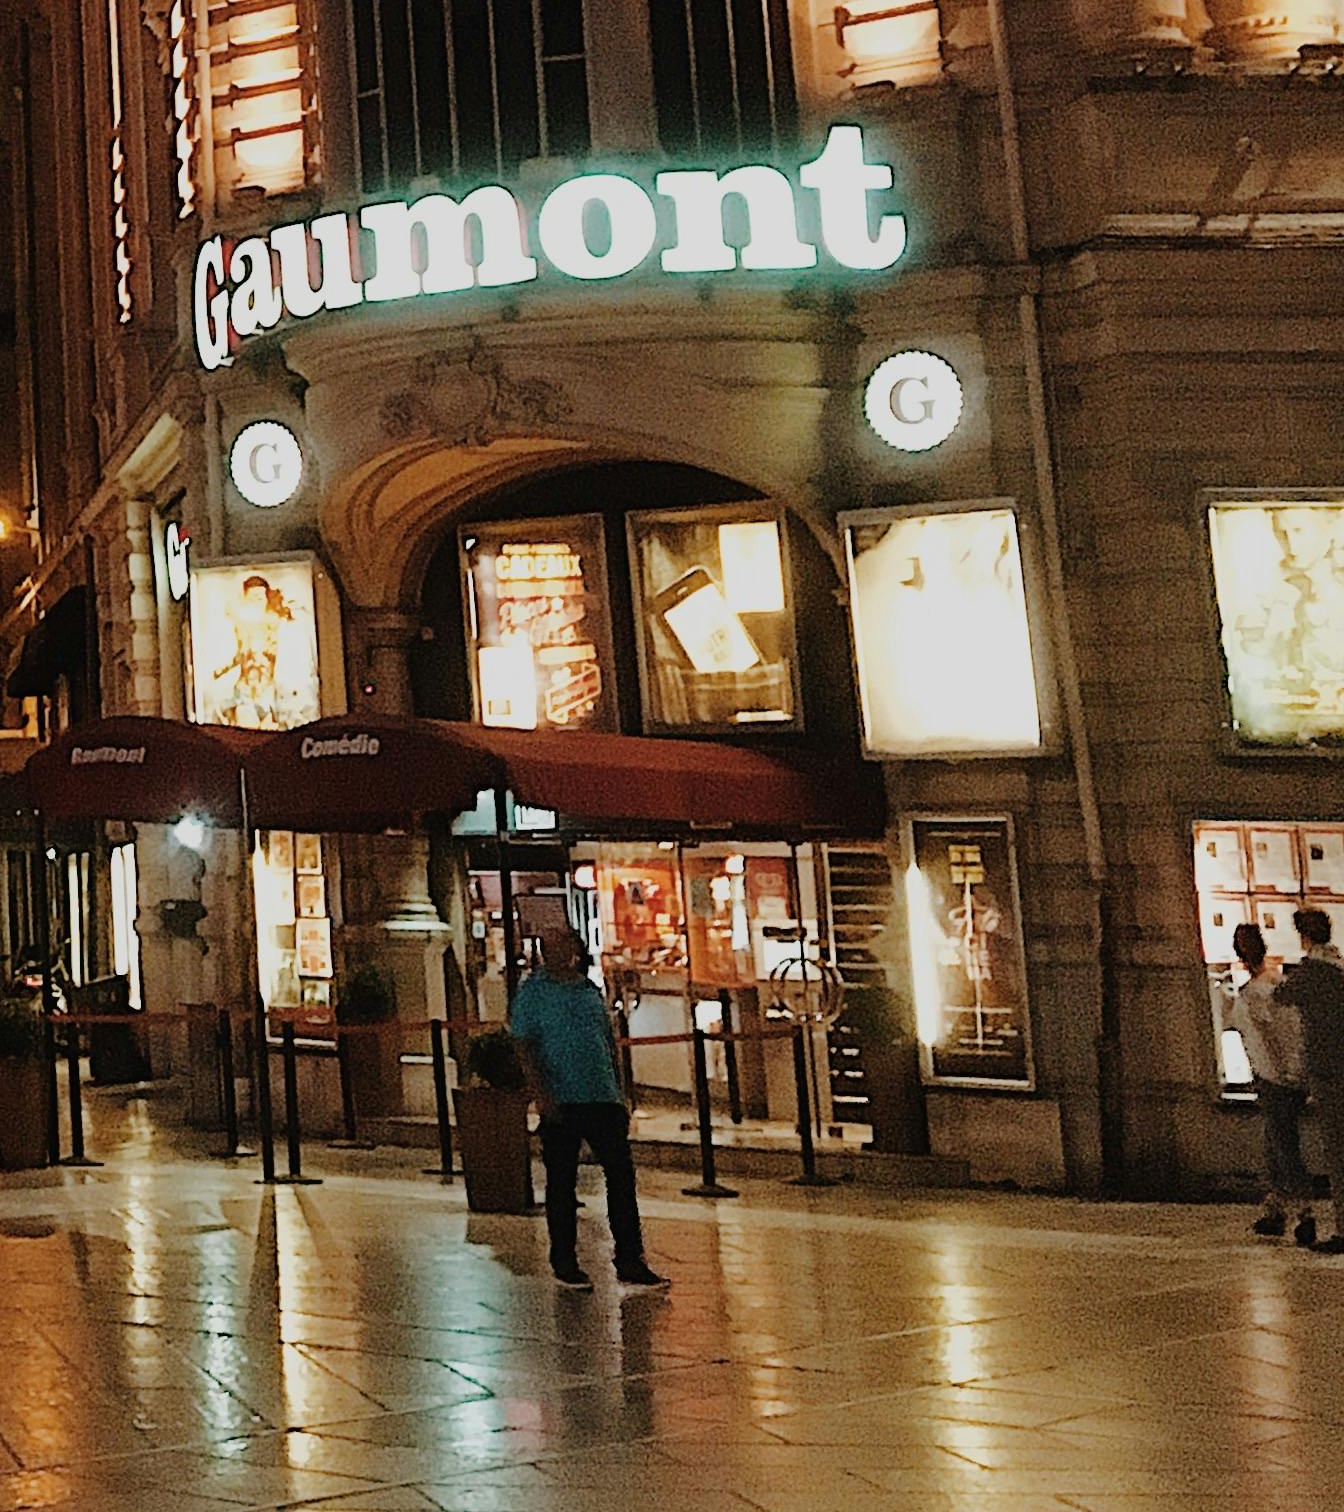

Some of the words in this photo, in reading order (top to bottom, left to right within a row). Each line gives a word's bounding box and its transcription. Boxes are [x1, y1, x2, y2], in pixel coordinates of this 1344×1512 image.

[193, 124, 909, 370] Gaumont
[889, 376, 935, 425] G
[249, 442, 282, 484] G
